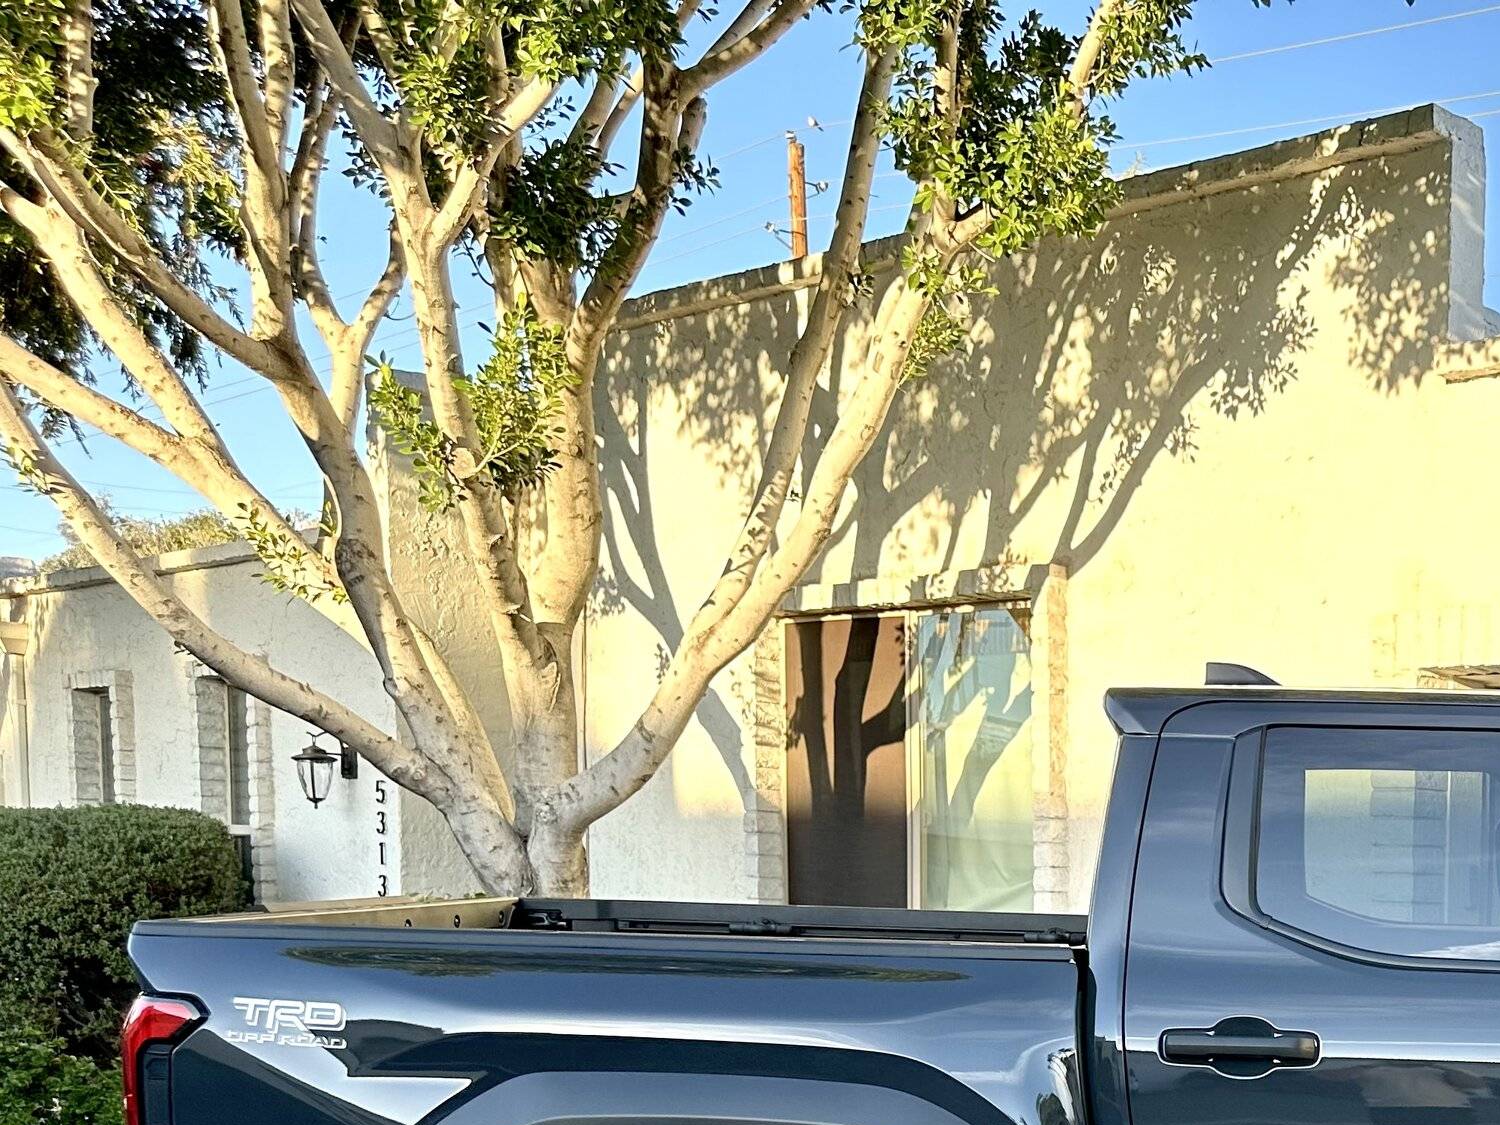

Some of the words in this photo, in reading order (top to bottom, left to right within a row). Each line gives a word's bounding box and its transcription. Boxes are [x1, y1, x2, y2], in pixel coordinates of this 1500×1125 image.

[376, 780, 388, 897] 5313
[233, 996, 347, 1031] TRD
[224, 1029, 275, 1044] OFF
[277, 1032, 347, 1049] ROAD
